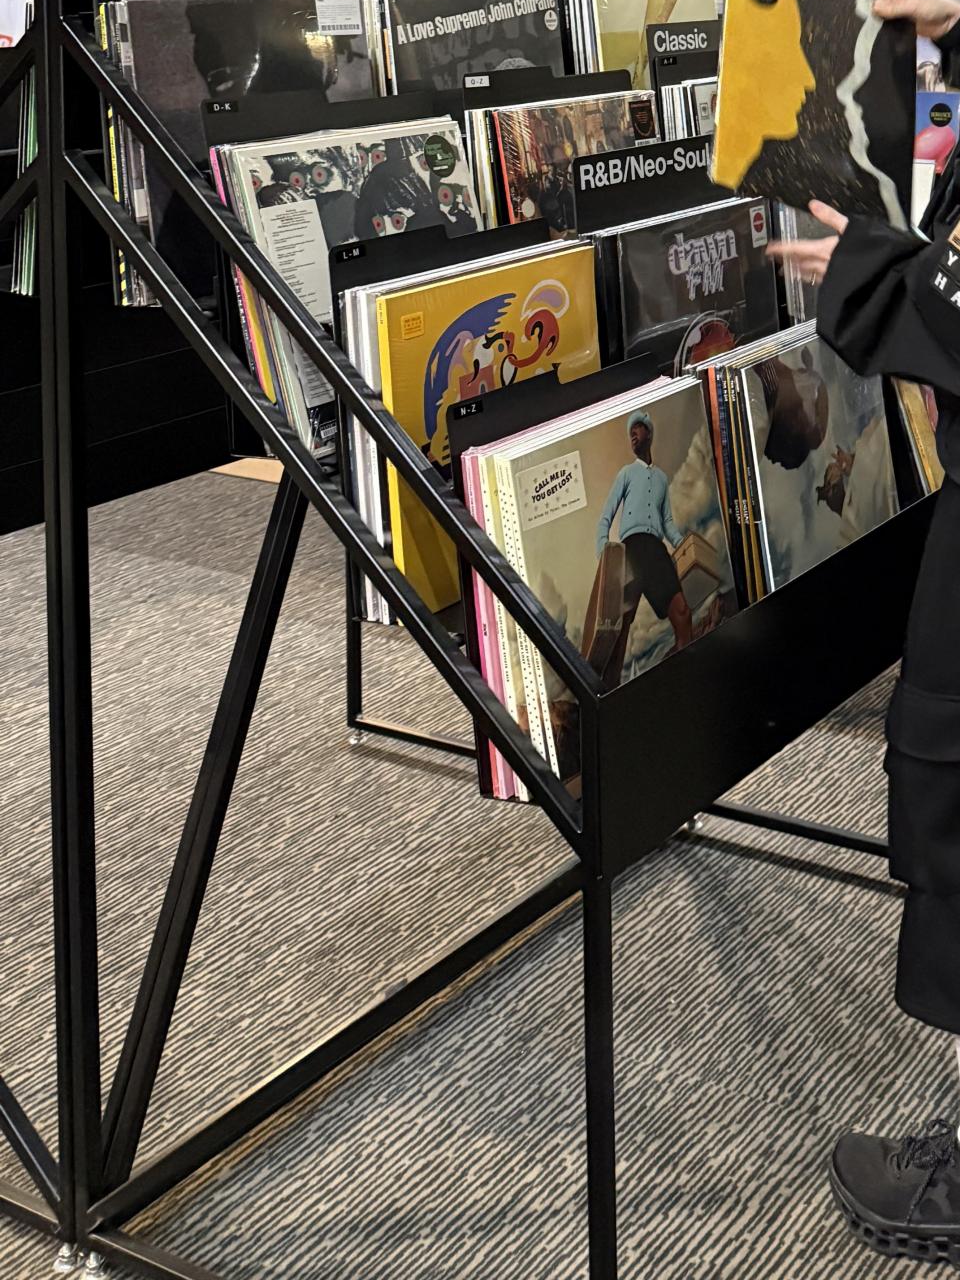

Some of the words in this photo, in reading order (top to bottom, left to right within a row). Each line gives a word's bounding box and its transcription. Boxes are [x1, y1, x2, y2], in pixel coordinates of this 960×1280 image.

[396, 25, 407, 45] A
[407, 21, 435, 43] Love
[435, 9, 487, 35] Supreme
[488, 2, 515, 23] John
[653, 28, 708, 52] Classic
[579, 143, 710, 190] R&B/Neo-Soul
[668, 229, 738, 275] dawn
[461, 404, 477, 415] N-Z
[532, 492, 546, 503] YOU
[546, 485, 558, 497] GET
[558, 472, 573, 489] LOST
[535, 478, 549, 493] CALL
[550, 472, 559, 482] ME
